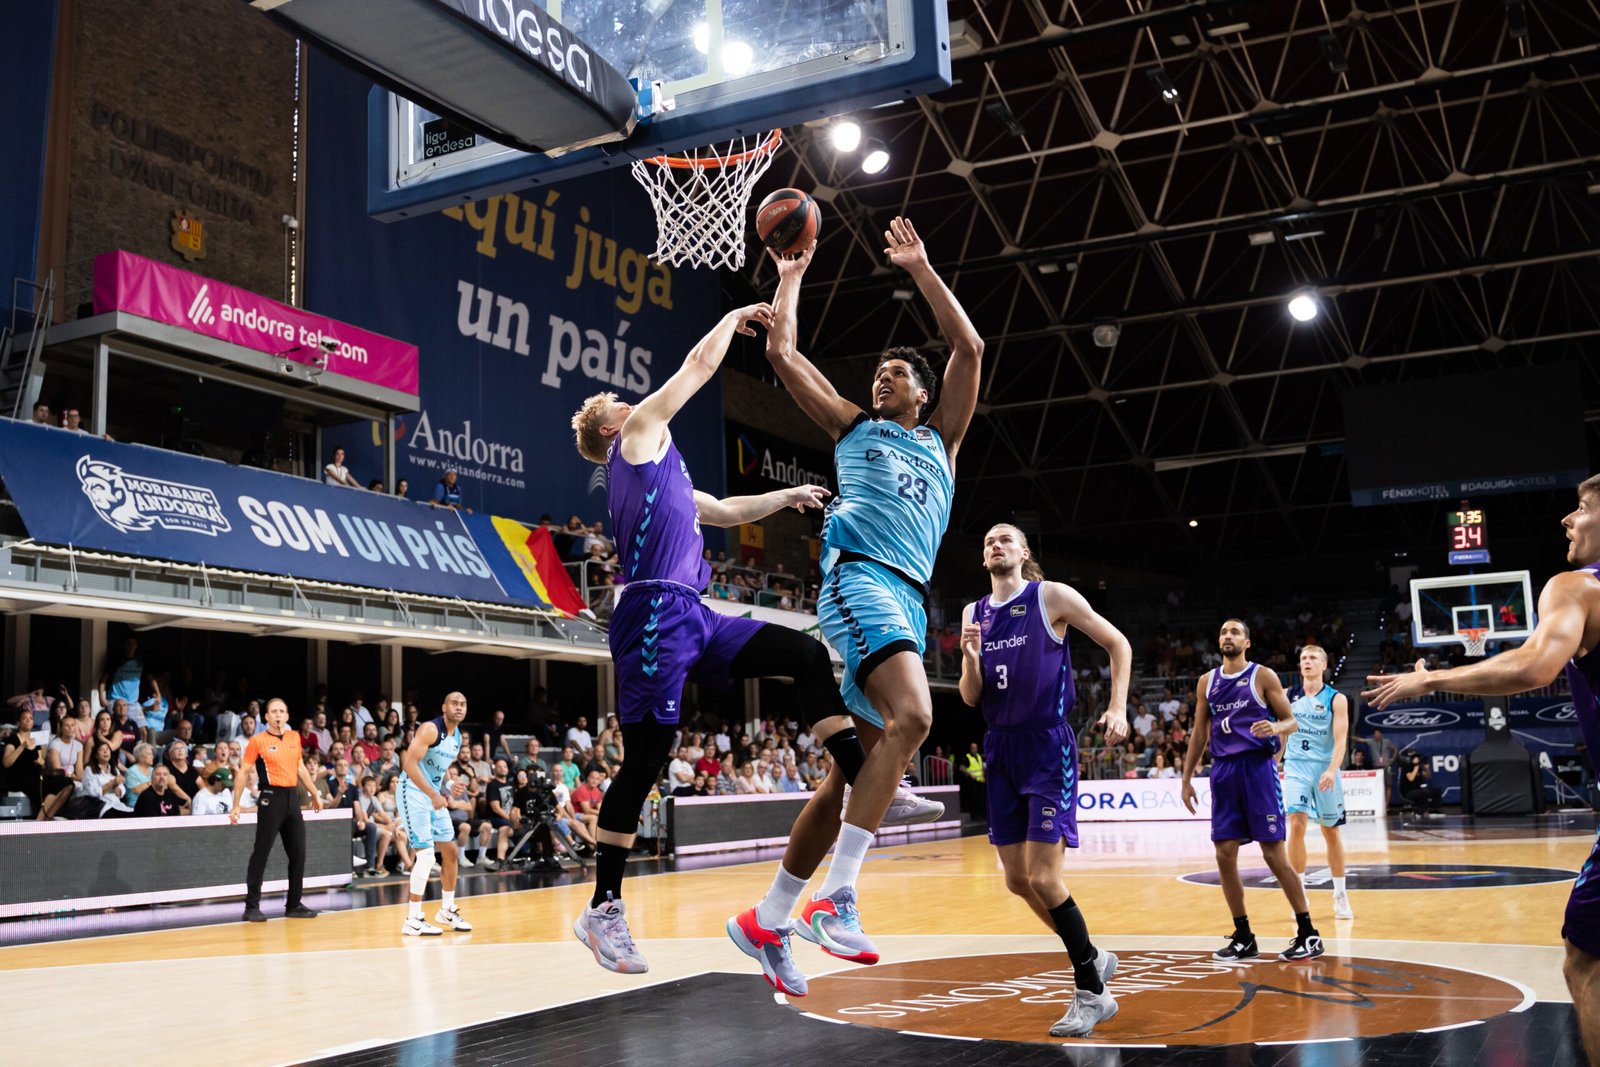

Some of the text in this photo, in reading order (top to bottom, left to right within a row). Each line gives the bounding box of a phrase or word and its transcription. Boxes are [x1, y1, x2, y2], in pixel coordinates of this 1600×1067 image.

[426, 131, 447, 146] liga
[426, 139, 473, 157] endesa
[565, 206, 674, 315] juga
[220, 303, 368, 365] andorra telcom
[457, 279, 653, 395] un país
[407, 409, 525, 474] Andorra
[760, 448, 829, 490] Andorra
[125, 478, 214, 505] MORABANC
[897, 473, 928, 506] 23
[134, 492, 225, 525] ANDORRA
[238, 495, 492, 579] SOM UN PAÍS
[1453, 526, 1481, 549] 3.4
[984, 635, 1028, 652] zunder
[995, 664, 1008, 690] 3
[1215, 699, 1249, 712] zunder
[1382, 711, 1442, 726] Ford
[1301, 739, 1310, 751] 8
